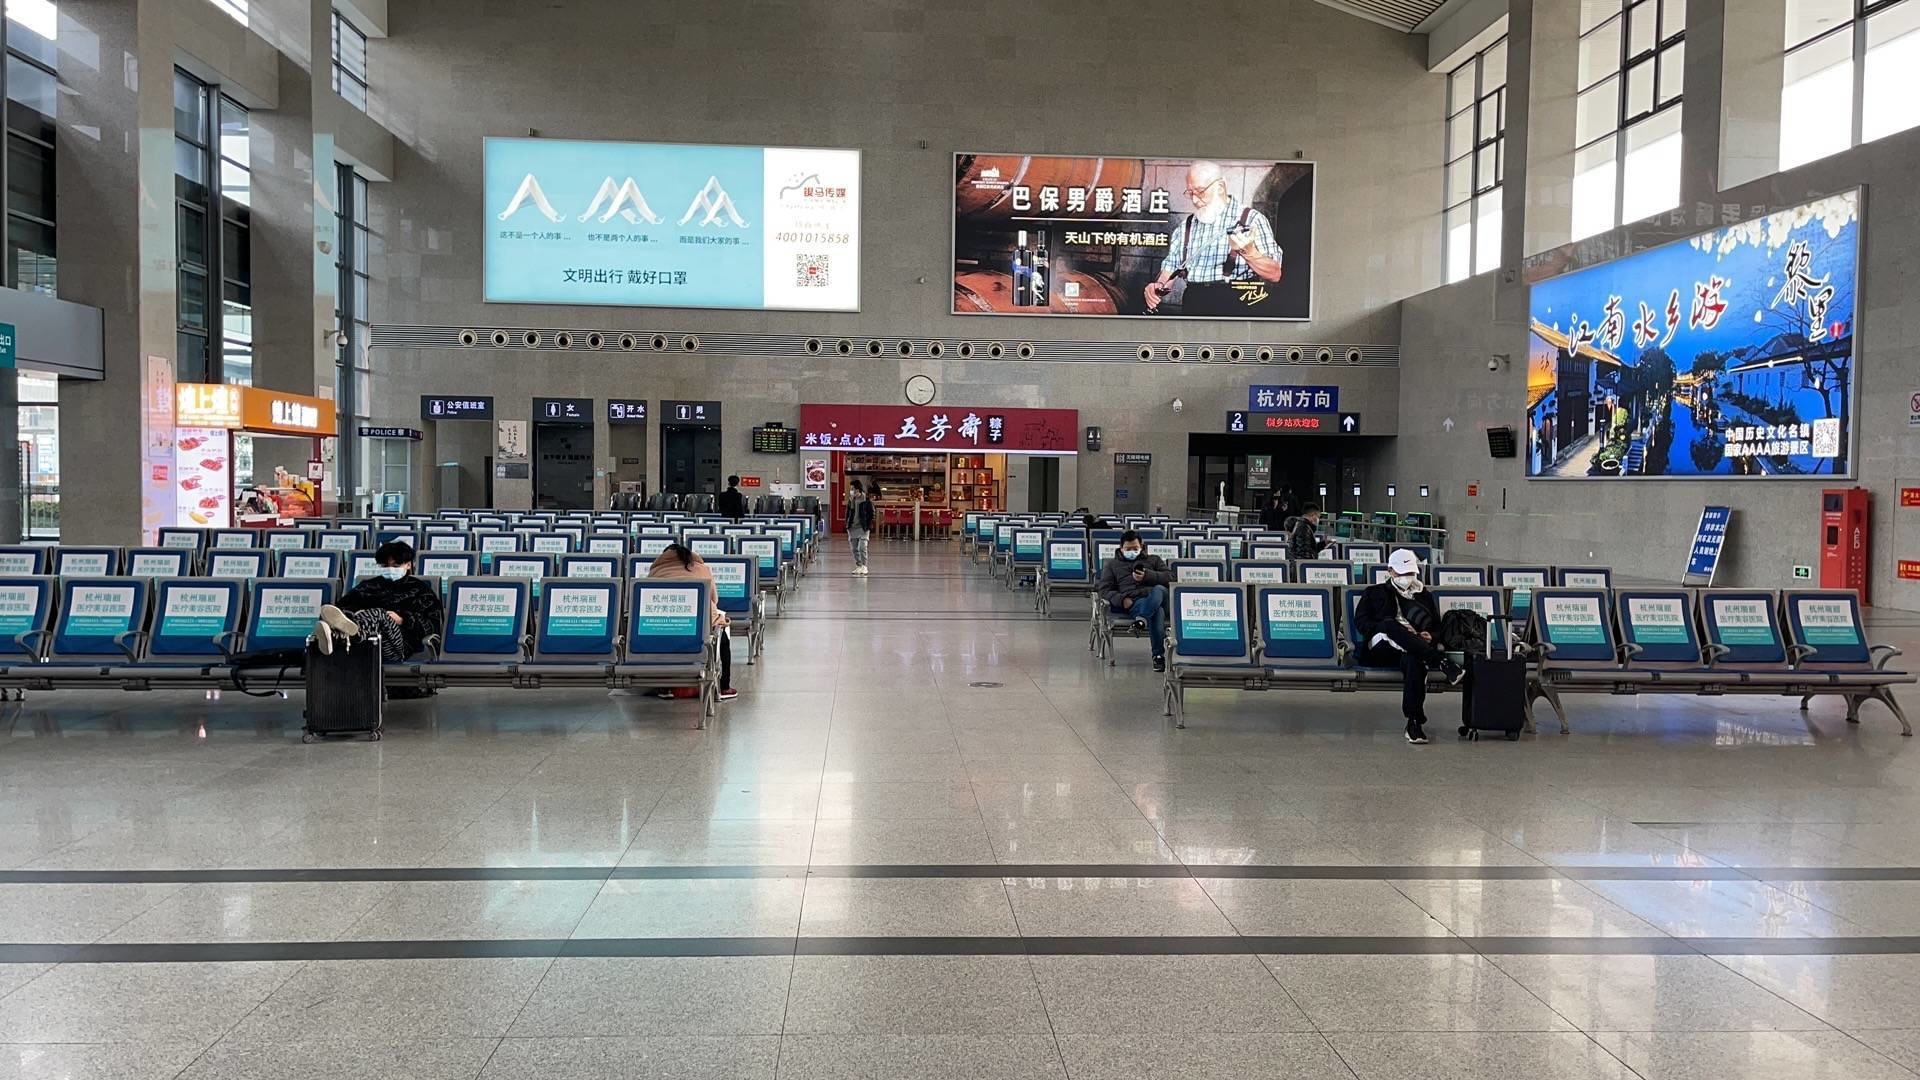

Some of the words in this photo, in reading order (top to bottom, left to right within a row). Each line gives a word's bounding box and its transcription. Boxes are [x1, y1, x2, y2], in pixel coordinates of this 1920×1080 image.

[1012, 186, 1169, 214] 巴保男爵酒庄
[776, 232, 850, 244] 4001015858
[1065, 231, 1169, 246] 天山下的有机酒庄
[562, 268, 623, 284] 文明出行
[628, 269, 688, 286] 戴好口罩
[1568, 275, 1730, 358] 江南水乡游
[1257, 389, 1330, 408] 杭州方向
[446, 401, 485, 410] 公安值班室
[566, 403, 575, 412] 女
[696, 406, 703, 414] 男
[1234, 412, 1242, 424] 2
[1266, 418, 1320, 428] 桐乡站欢迎您
[989, 417, 1002, 441] 粽子
[1725, 423, 1810, 442] 中国历史文化名镇
[1724, 440, 1808, 457] 国家AAAA旅游景区
[86, 592, 122, 602] 杭州瑞丽
[180, 594, 216, 602] 杭州瑞丽
[274, 594, 310, 603] 杭州瑞丽
[470, 594, 504, 602] 杭州瑞丽
[562, 594, 597, 603] 杭州瑞丽
[652, 594, 686, 604] 杭州瑞丽
[76, 604, 126, 612] 医疗美容医院
[462, 604, 510, 612] 医疗美容医院
[1192, 599, 1224, 608] 杭州瑞丽
[1279, 600, 1312, 608] 杭州瑞丽
[1450, 602, 1482, 610] 杭州瑞丽
[1556, 604, 1588, 612] 杭州瑞丽
[1640, 604, 1672, 612] 杭州瑞丽
[172, 604, 222, 613] 医疗美容医院
[266, 606, 316, 614] 医疗美容医院
[556, 605, 602, 614] 医疗美容医院
[644, 605, 692, 614] 医疗美容医院
[1724, 605, 1756, 614] 杭州瑞丽
[1809, 605, 1840, 614] 杭州瑞丽
[1186, 610, 1232, 618] 医疗美容医院
[1274, 610, 1318, 618] 医疗美容医院
[1551, 614, 1594, 622] 医疗美容医院
[1636, 614, 1679, 622] 医疗美容医院
[1720, 616, 1764, 624] 医疗美容医院
[1804, 616, 1848, 624] 医疗美容医院
